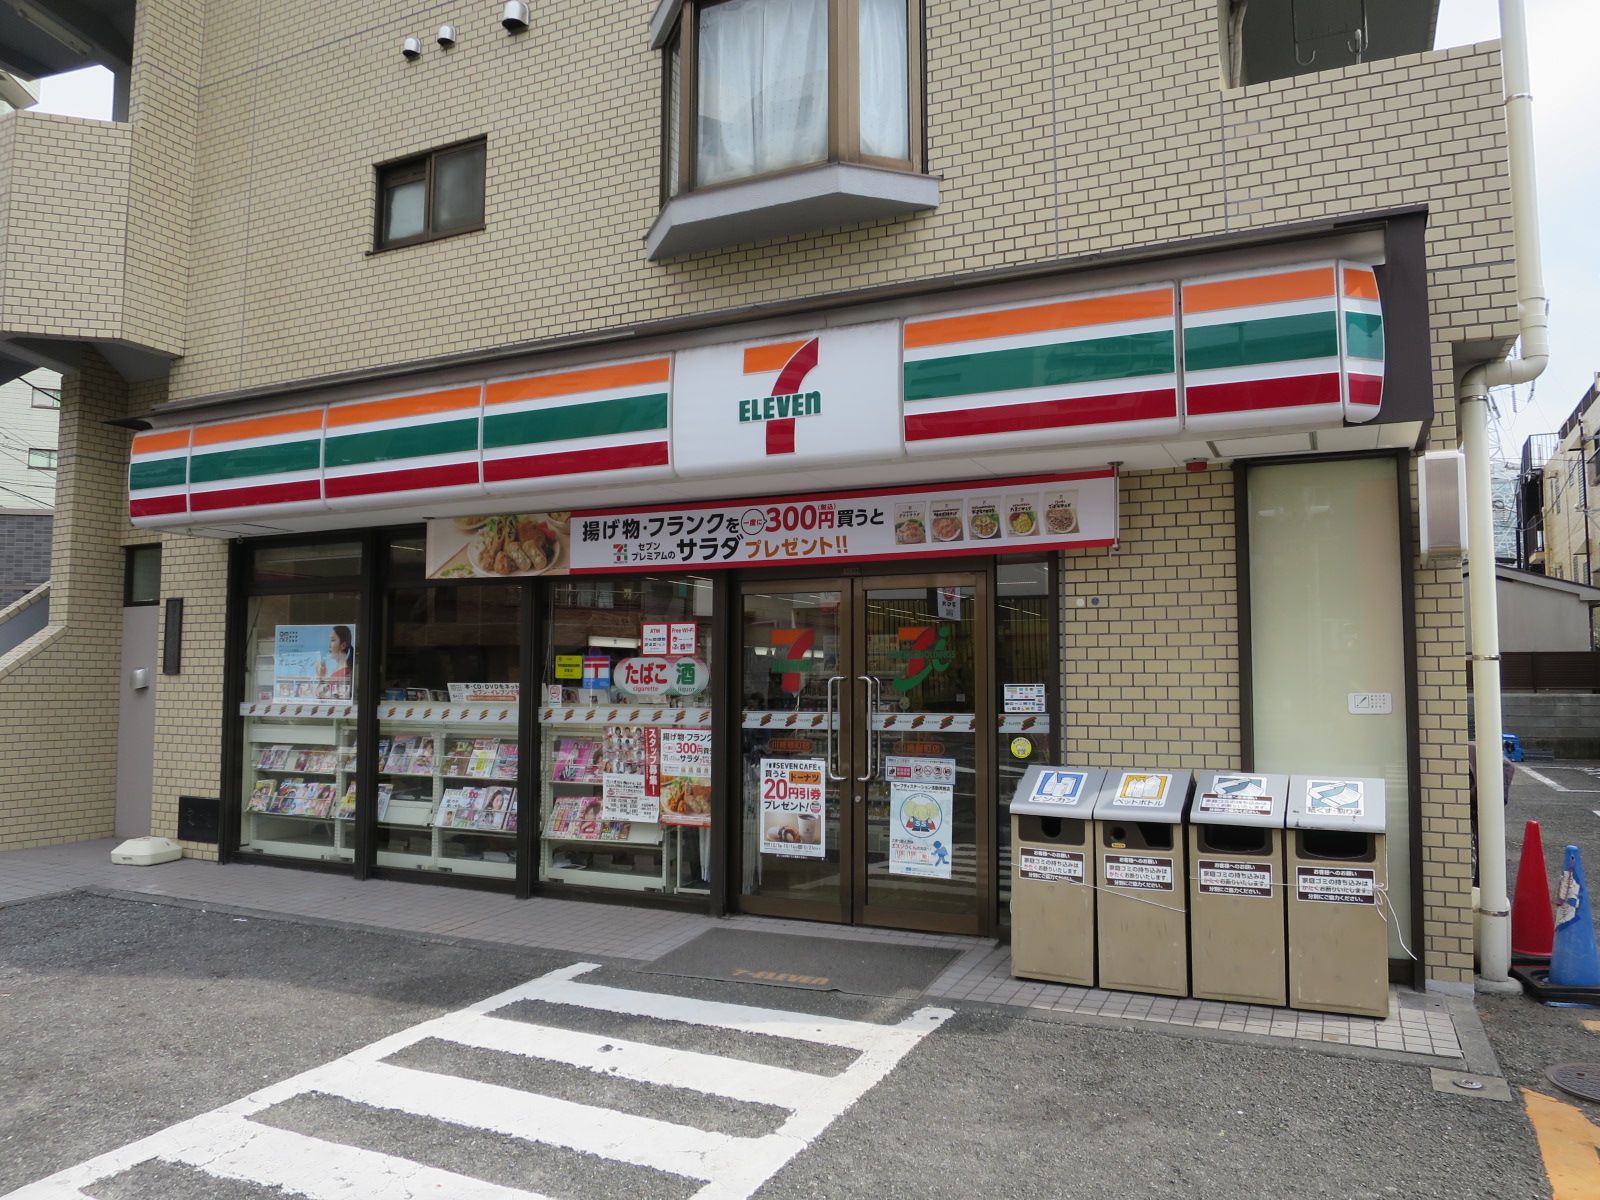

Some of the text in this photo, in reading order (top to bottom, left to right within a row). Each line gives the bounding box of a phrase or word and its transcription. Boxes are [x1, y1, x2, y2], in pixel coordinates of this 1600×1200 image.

[743, 336, 819, 455] 7
[582, 513, 740, 542] 揚げ物・フランクを
[743, 518, 762, 527] 一度に
[765, 504, 835, 532] 300円
[837, 508, 884, 528] 買うと
[638, 542, 661, 551] セブン
[676, 534, 848, 562] サラダ プレゼント!!
[631, 550, 676, 561] プレミアムの
[625, 662, 668, 684] たばこ
[676, 662, 696, 685] 酒
[680, 754, 700, 763] サラダ
[776, 762, 798, 770] SEVEN
[765, 769, 786, 778] 買うと
[790, 772, 819, 782] ドーナツ
[764, 778, 822, 800] 20円引券
[764, 800, 809, 812] プレゼント!
[1114, 799, 1164, 807] ペットボトル
